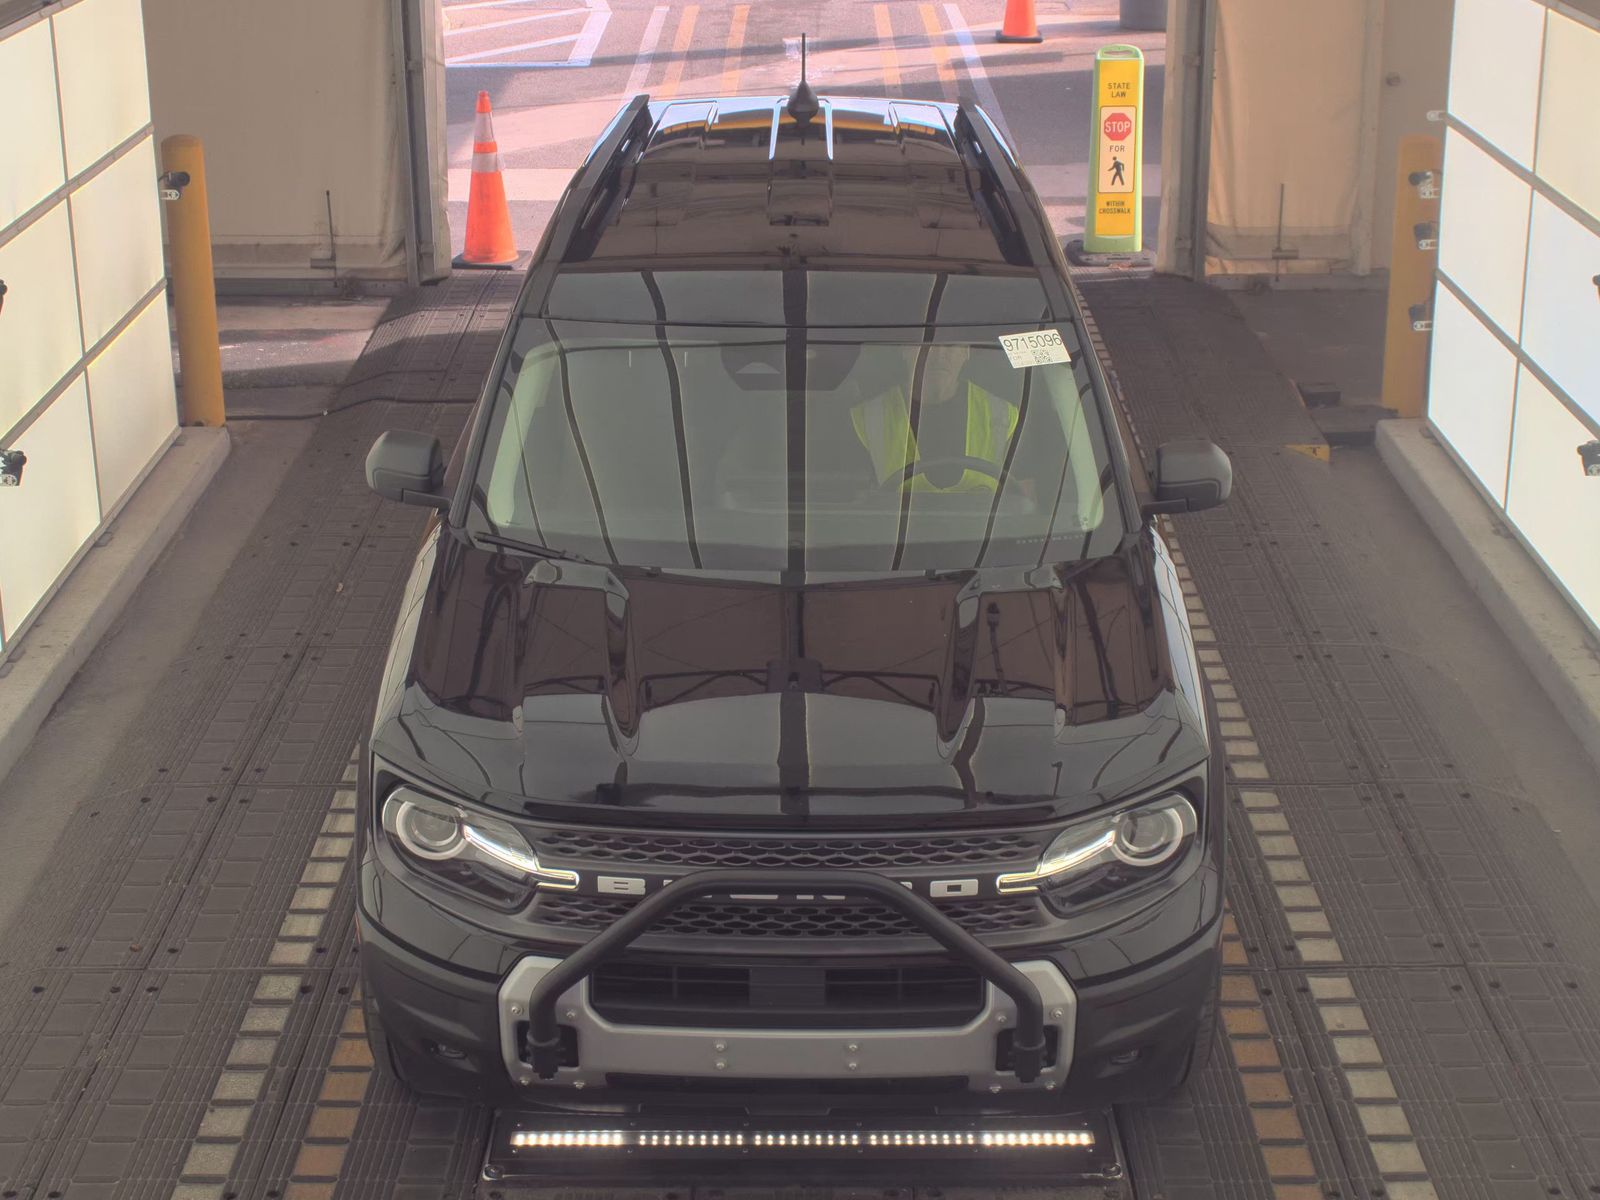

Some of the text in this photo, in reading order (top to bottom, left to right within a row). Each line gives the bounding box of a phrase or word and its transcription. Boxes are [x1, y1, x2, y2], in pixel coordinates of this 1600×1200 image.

[1107, 82, 1131, 90] STATE
[1111, 90, 1127, 98] LAW
[1105, 120, 1131, 133] STOP
[1003, 333, 1063, 352] 9715096
